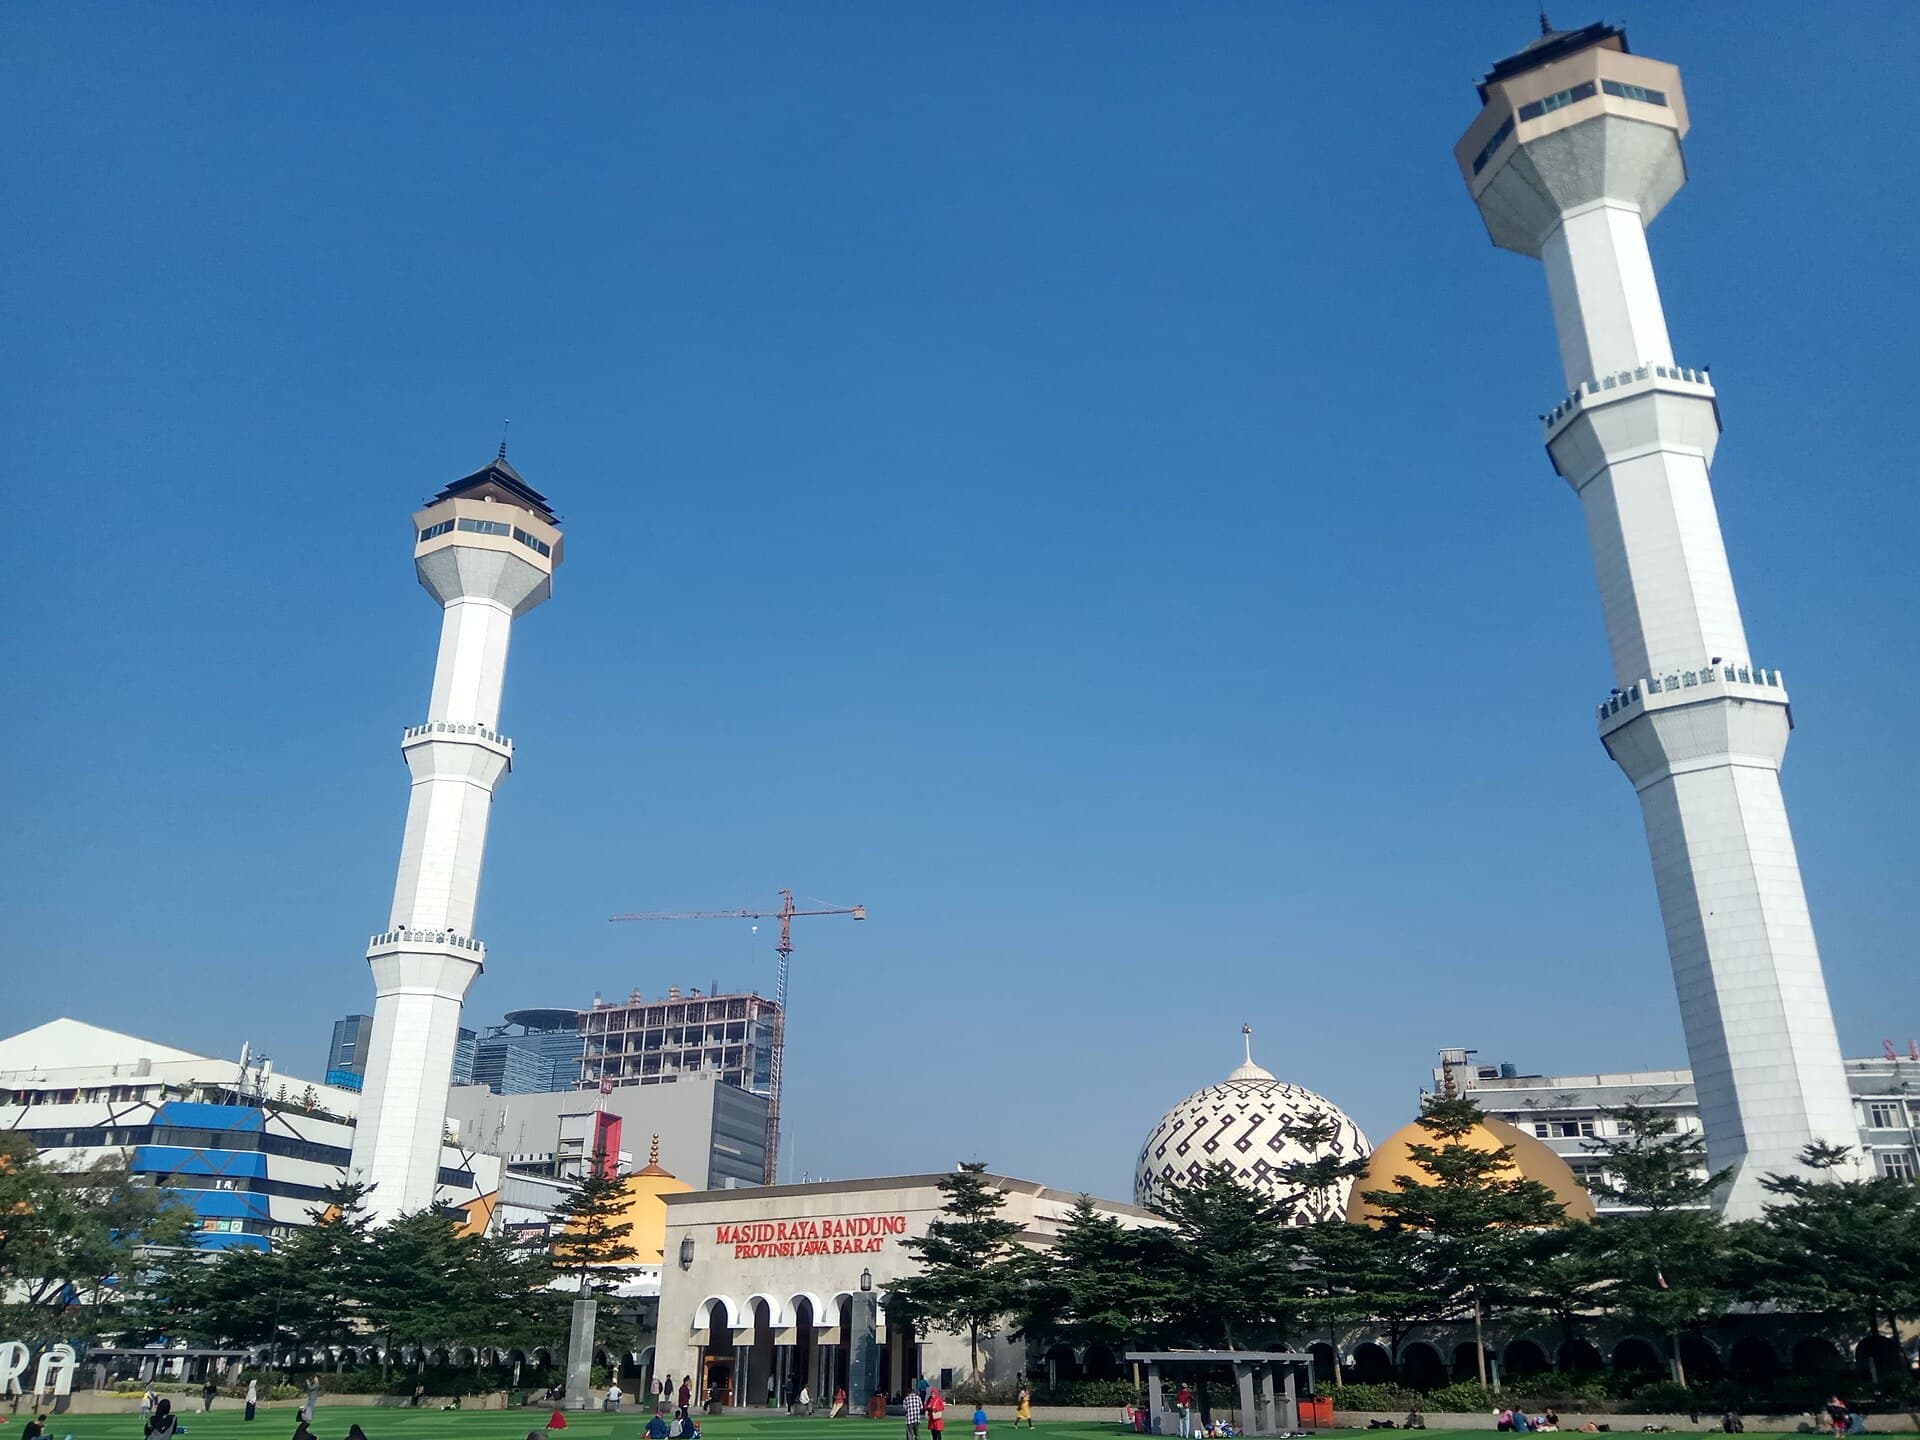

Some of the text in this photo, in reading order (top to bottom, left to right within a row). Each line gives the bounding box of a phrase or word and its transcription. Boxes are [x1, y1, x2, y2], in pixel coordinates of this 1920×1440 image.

[716, 1217, 906, 1244] MASJID RAYA BANDUNG
[735, 1239, 883, 1259] PROVINSI JAWA BARAT
